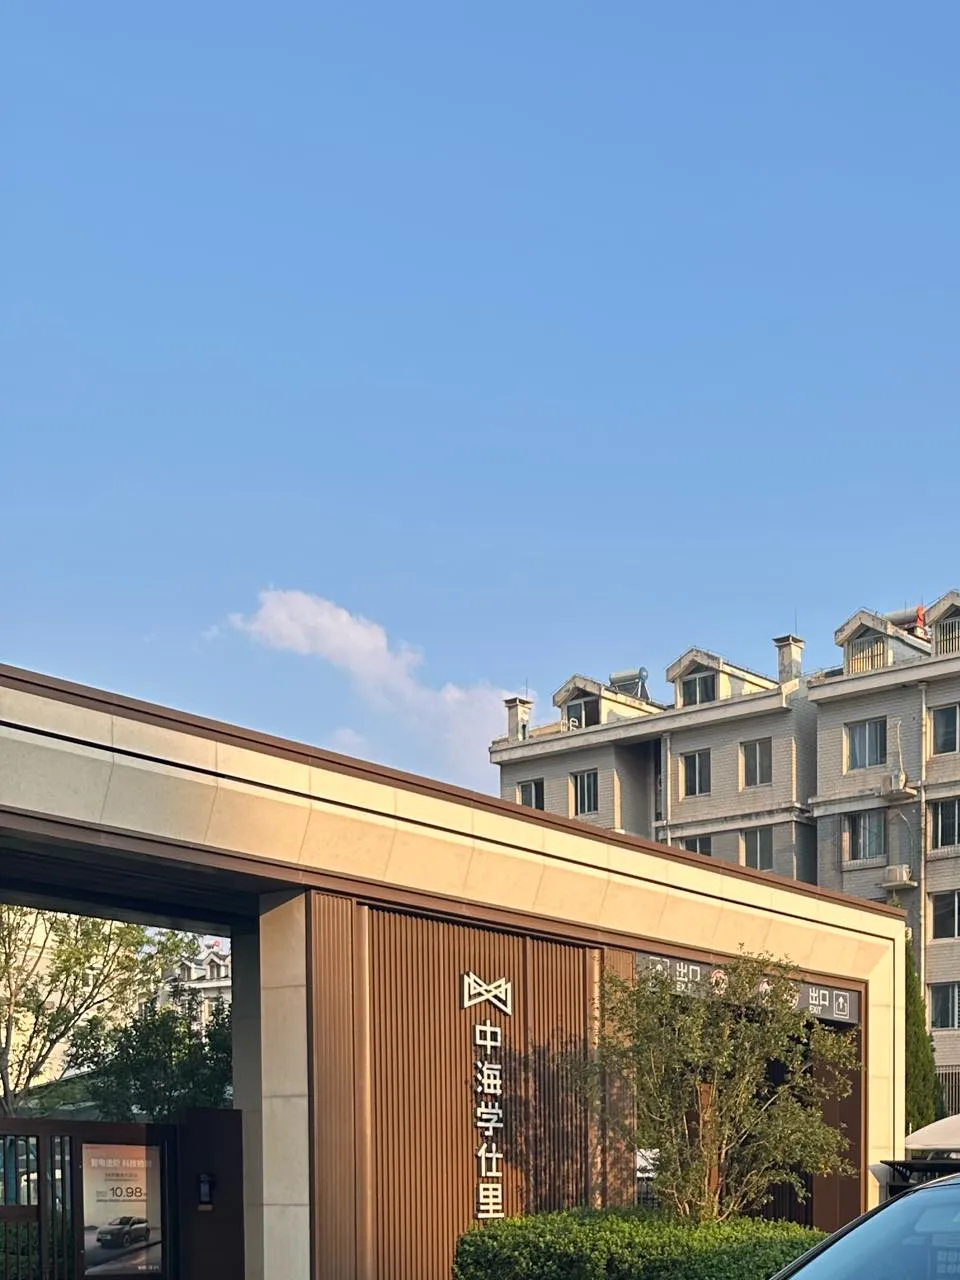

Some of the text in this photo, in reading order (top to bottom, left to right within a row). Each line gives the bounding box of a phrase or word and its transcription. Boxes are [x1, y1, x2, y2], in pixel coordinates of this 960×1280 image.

[676, 961, 701, 982] 出口
[809, 986, 830, 1007] 出口
[809, 1005, 823, 1015] EXIT
[475, 1019, 505, 1218] 中海学仕里
[109, 1186, 143, 1198] 10.98
